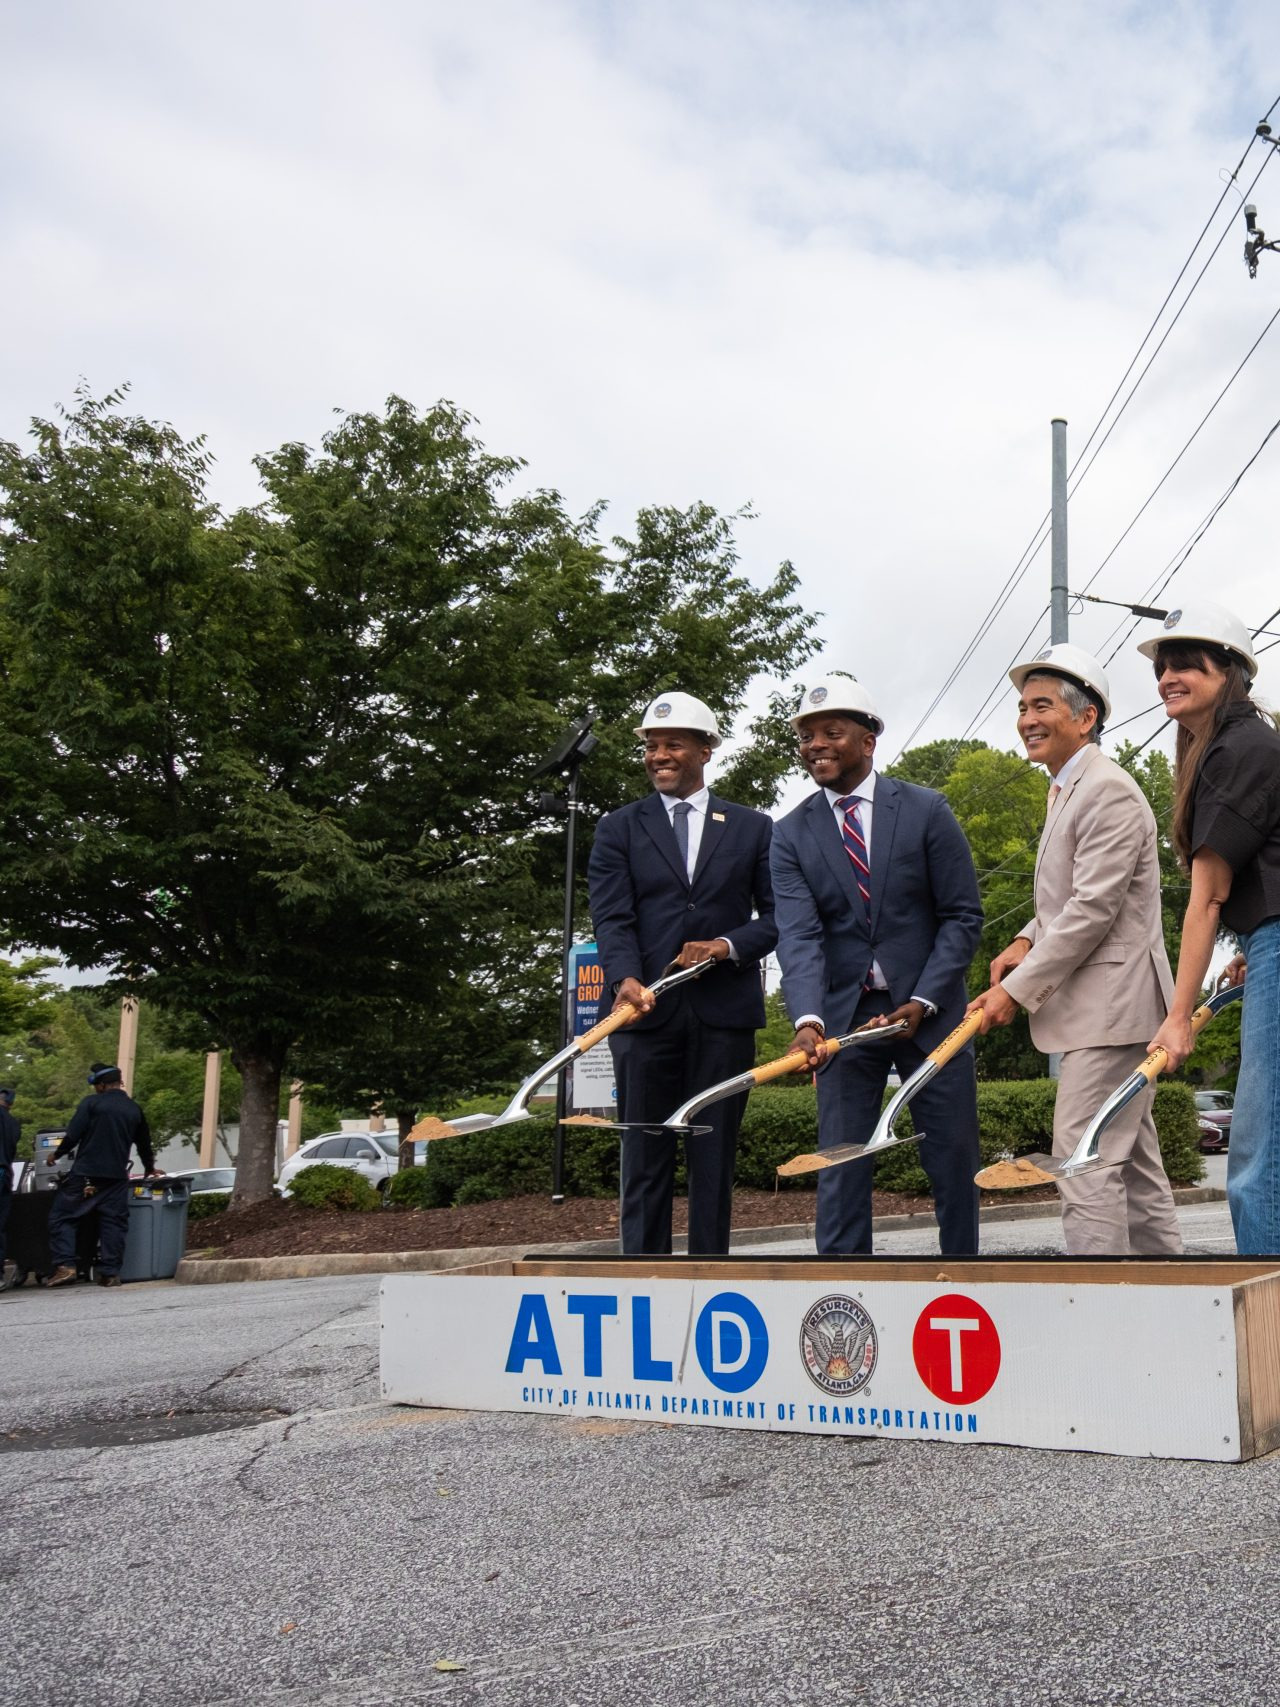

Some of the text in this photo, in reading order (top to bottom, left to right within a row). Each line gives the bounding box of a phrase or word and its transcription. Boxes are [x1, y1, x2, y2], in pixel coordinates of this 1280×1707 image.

[577, 984, 604, 1002] GRO
[809, 1301, 868, 1328] RESURGENS
[504, 1293, 980, 1393] ATL D T
[522, 1386, 978, 1433] CITY OF ATLANTA DEPARTMENT OF TRANSPORTATION
